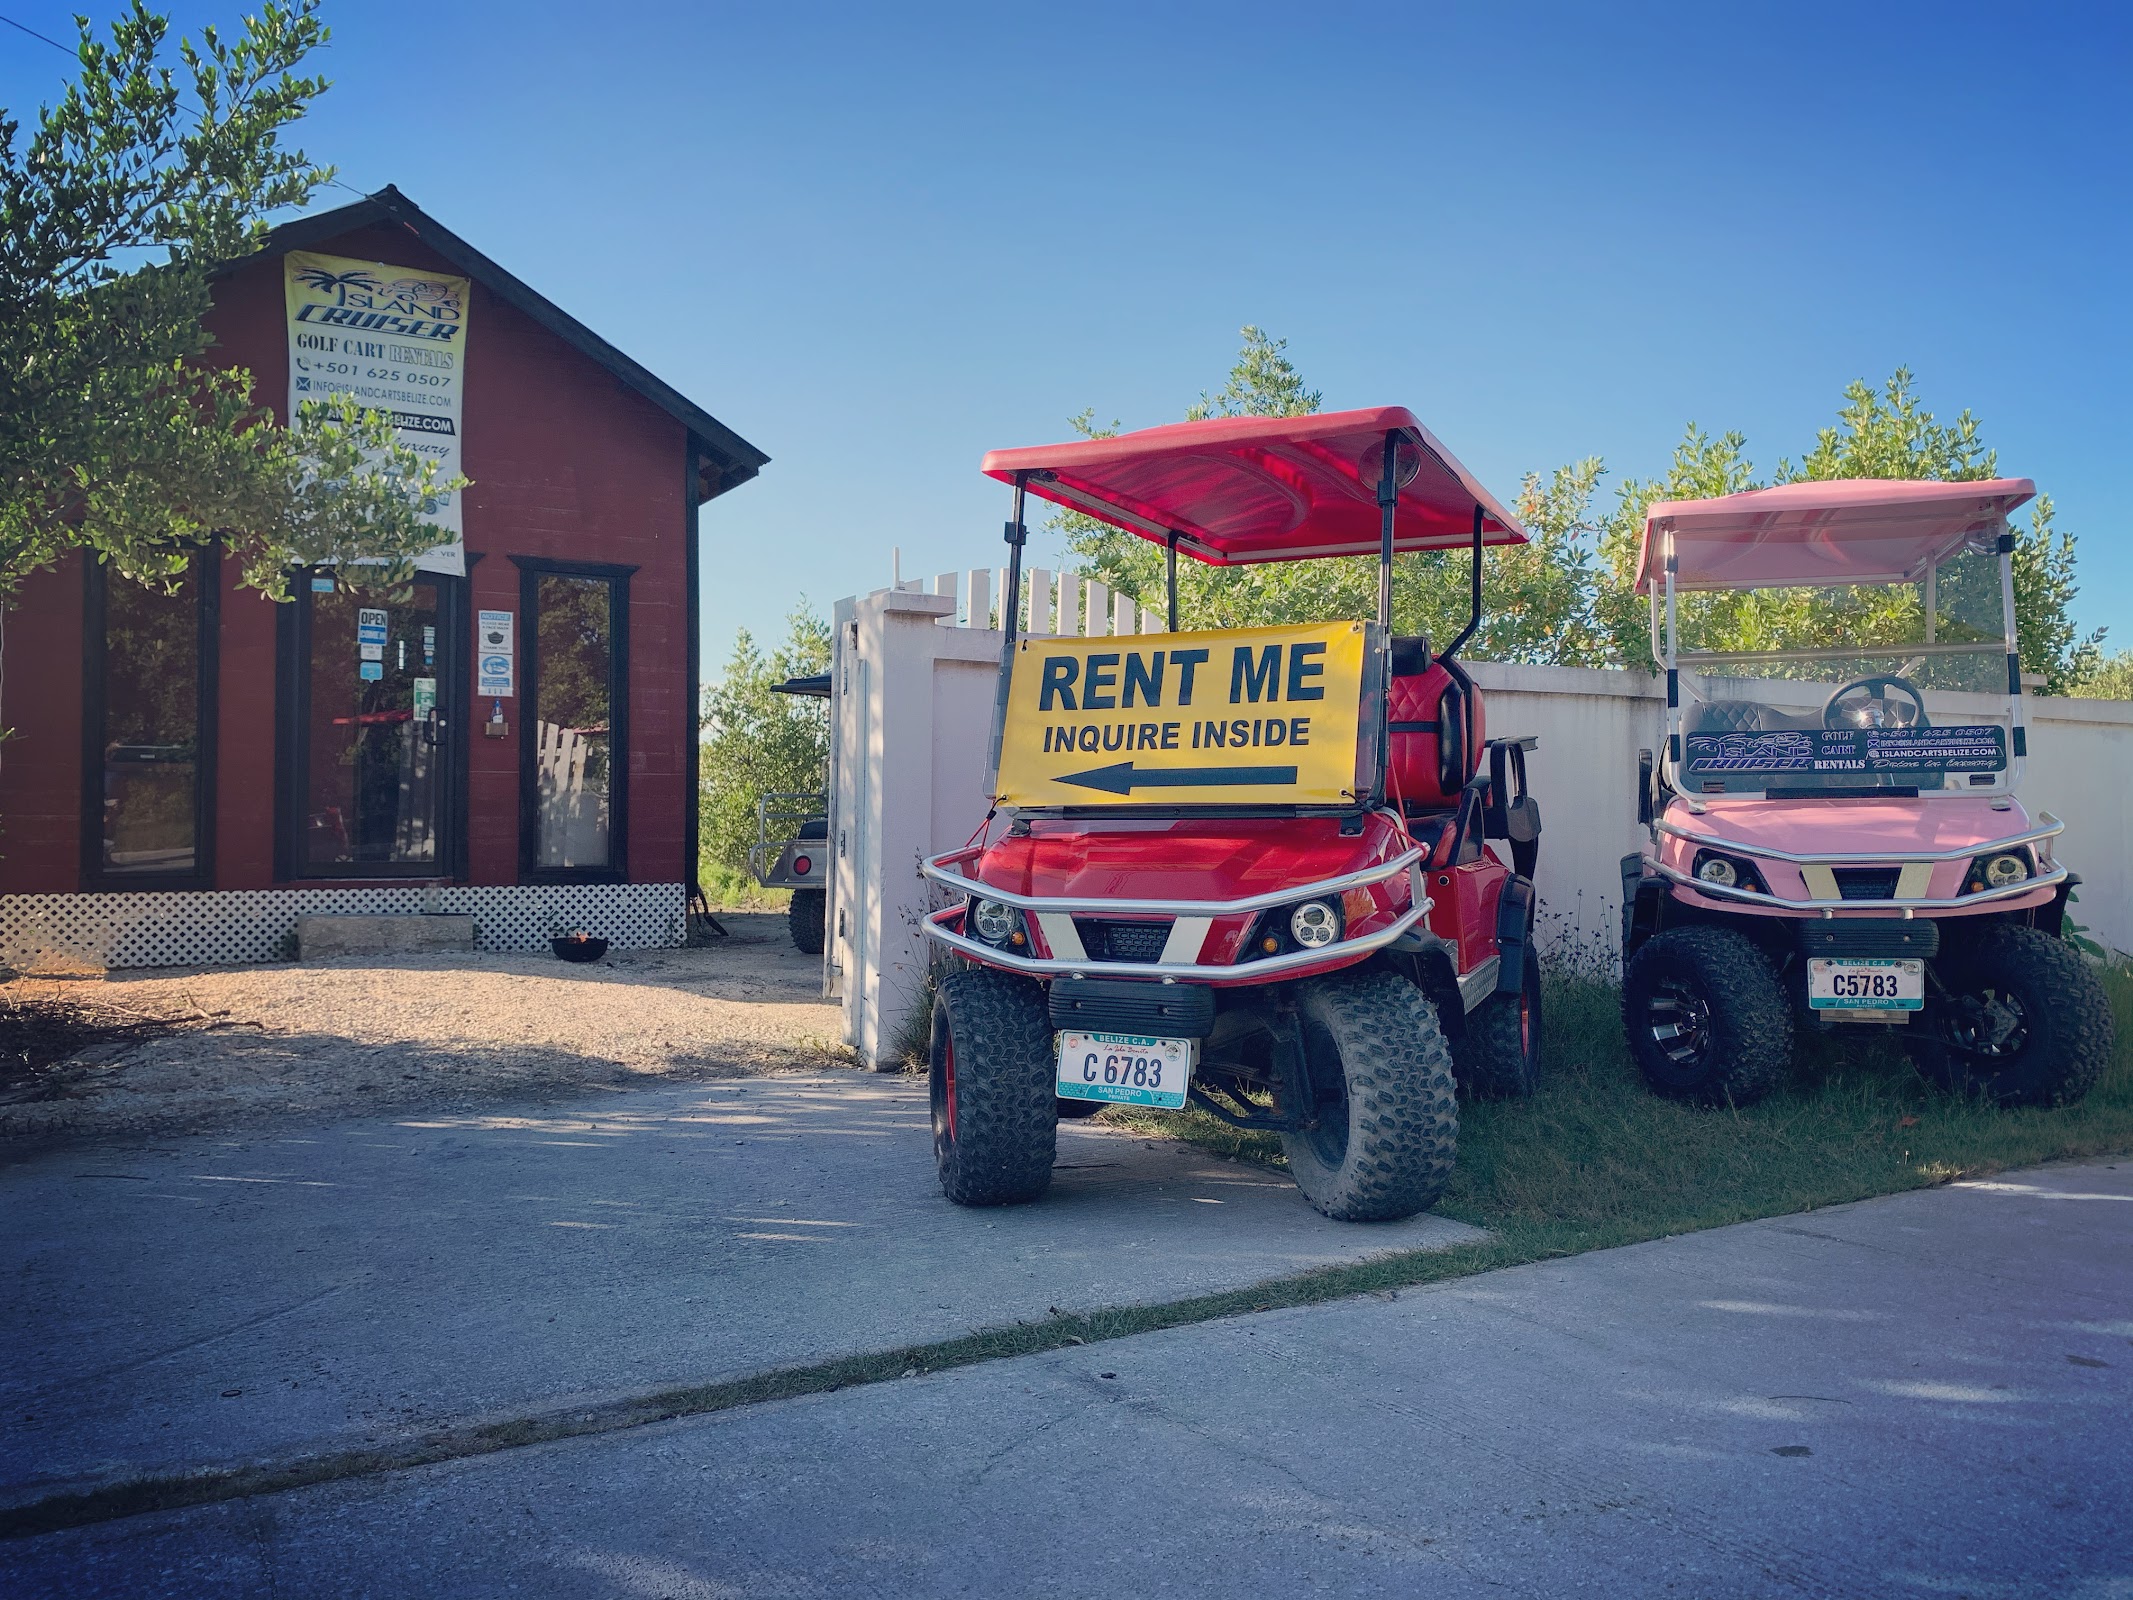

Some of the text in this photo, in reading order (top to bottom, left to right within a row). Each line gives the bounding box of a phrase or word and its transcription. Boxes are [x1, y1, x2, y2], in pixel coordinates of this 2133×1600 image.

[295, 304, 460, 341] CRUISER
[297, 333, 454, 369] GOLF CART RENTALS
[313, 361, 451, 387] +501 625 0507
[361, 611, 387, 626] OPEN
[481, 613, 510, 621] NOTICE
[1038, 641, 1327, 711] RENT ME
[1043, 717, 1310, 754] INQUIRE INSIDE
[1821, 731, 1854, 741] GOLF
[1880, 727, 1994, 738] +501 625 0507
[1821, 745, 1857, 755] CART
[1881, 748, 1997, 758] ISLANDCARTSBELIZE.COM
[1689, 757, 1814, 772] CRUISER
[1814, 759, 1866, 769] RENTALS
[1833, 974, 1898, 997] C5783
[1099, 1034, 1150, 1046] BELIZE C.A.
[1083, 1053, 1162, 1088] C 6783
[1098, 1086, 1142, 1097] SAN PEDRO
